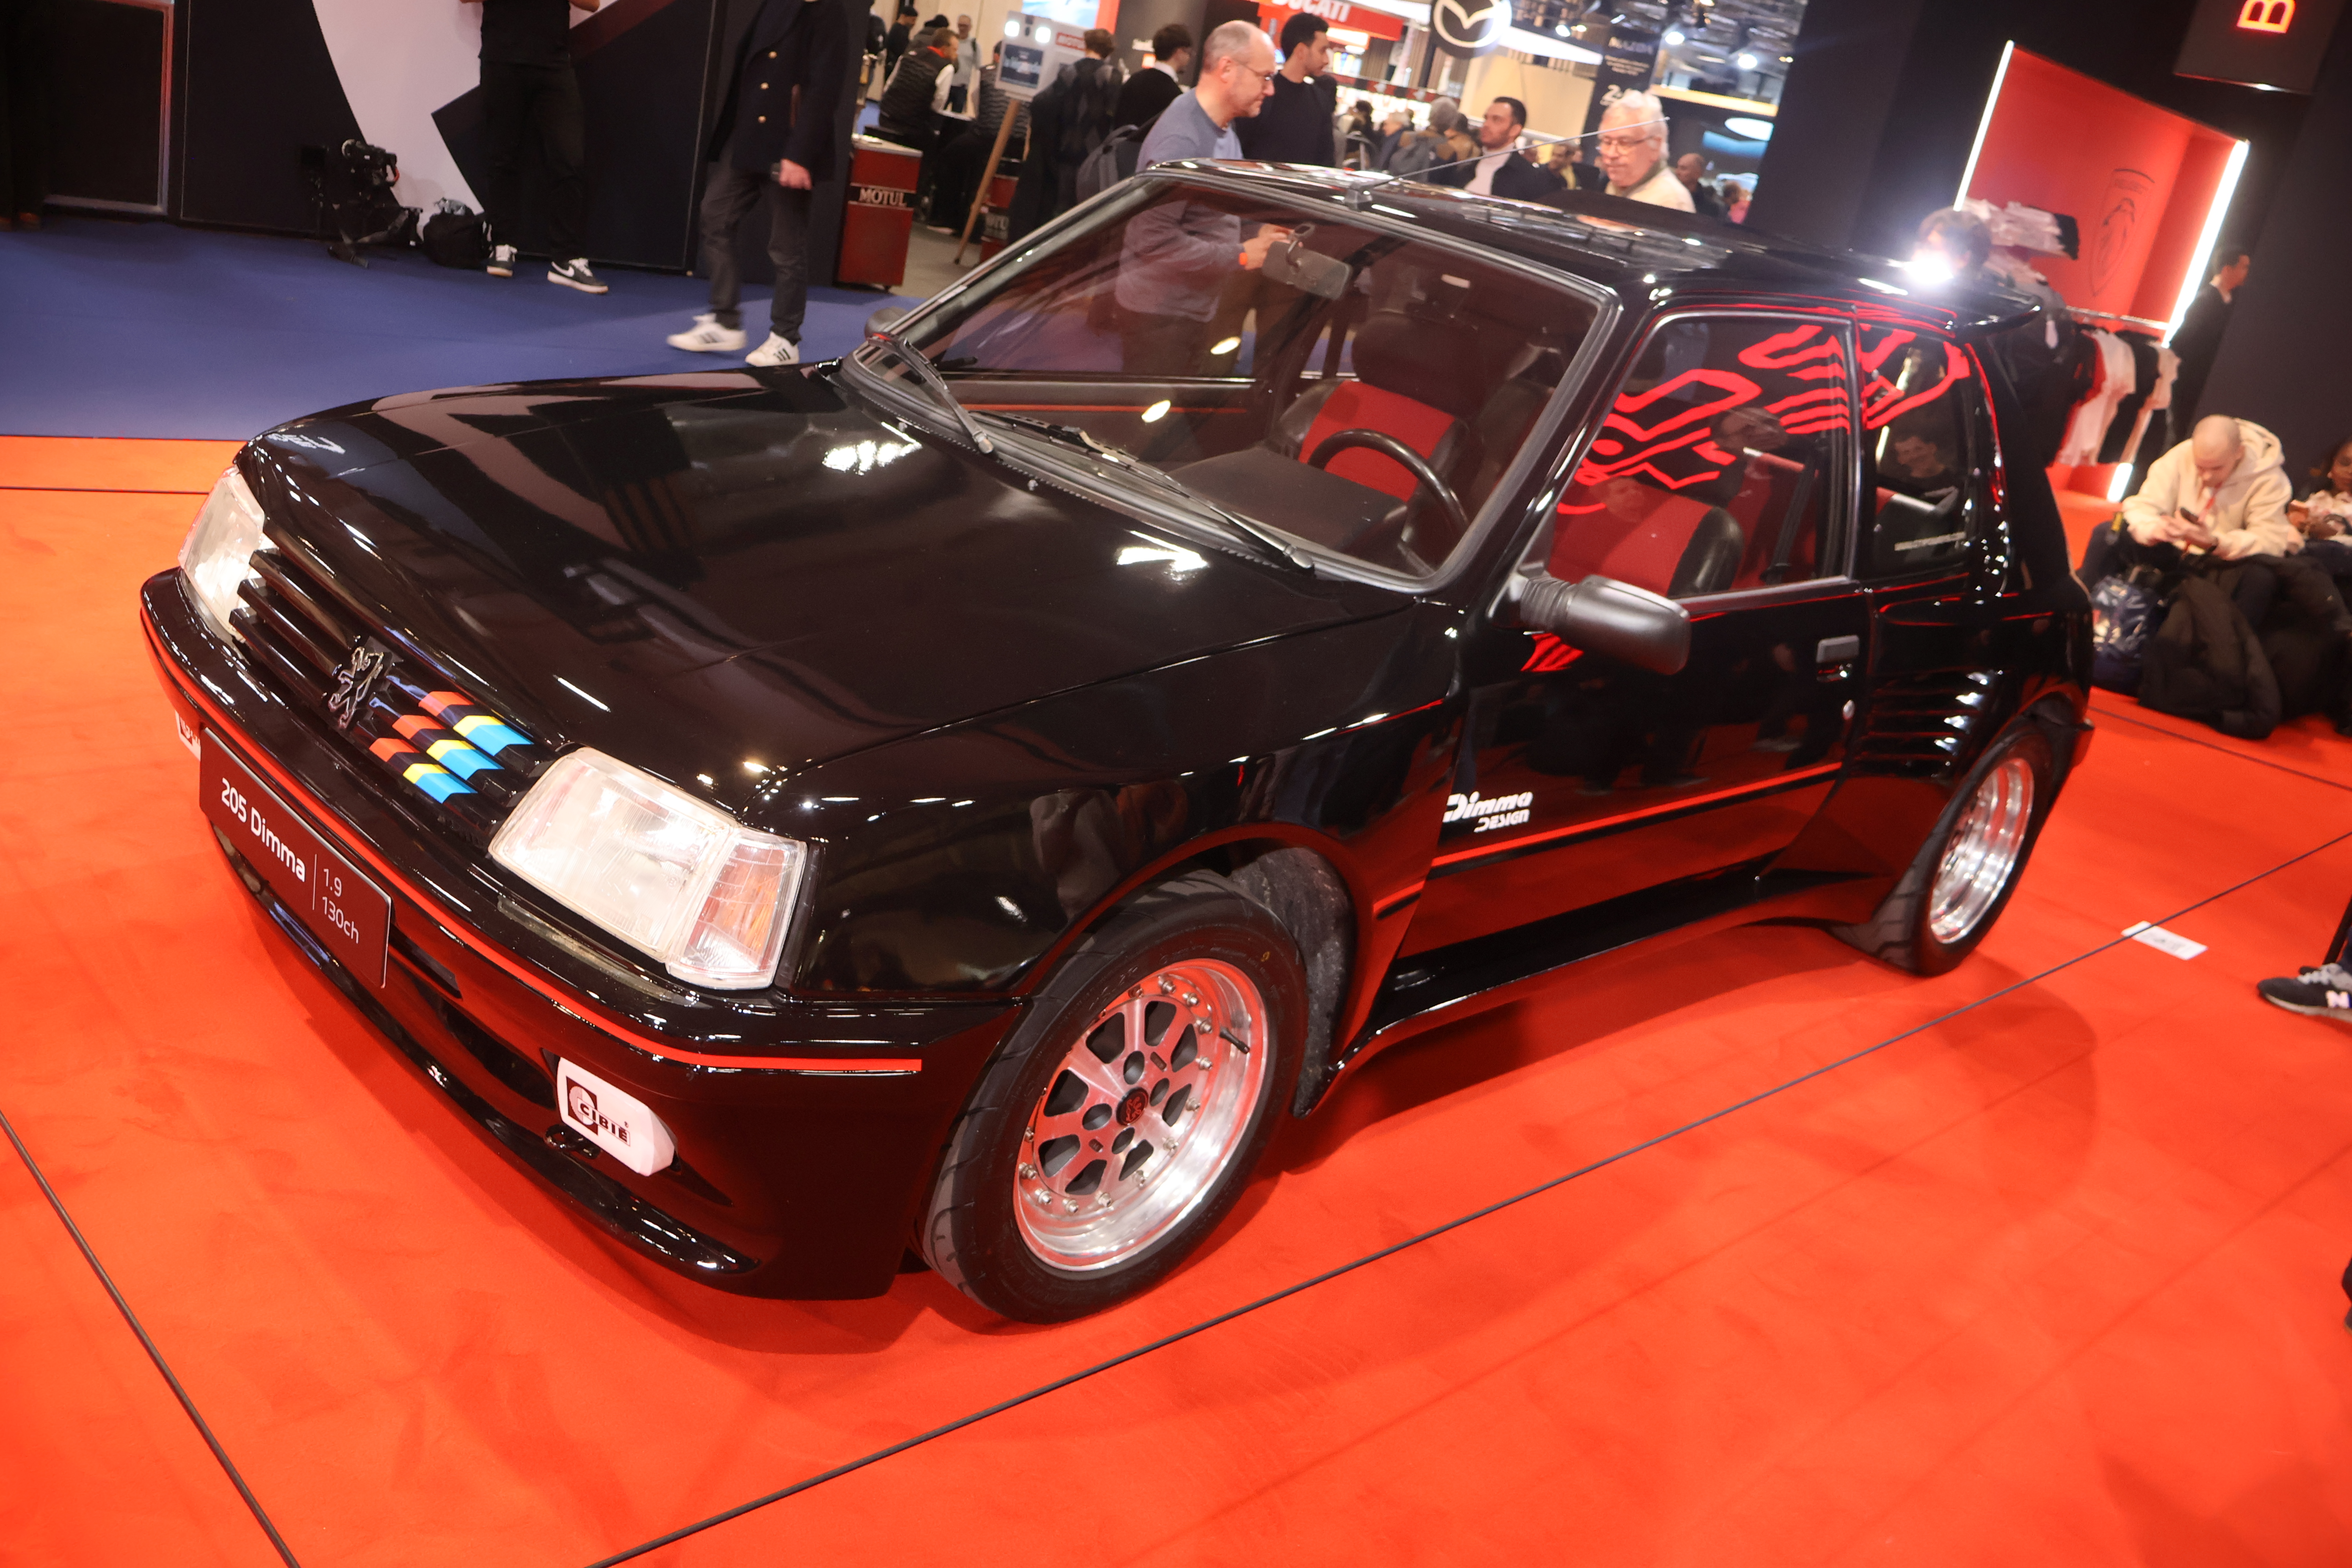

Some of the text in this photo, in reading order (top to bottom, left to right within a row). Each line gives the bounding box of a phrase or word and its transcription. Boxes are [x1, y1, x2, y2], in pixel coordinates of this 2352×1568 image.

[858, 187, 907, 207] MOTUL
[1442, 791, 1533, 822] Dimma
[221, 777, 305, 882] 205 Dimma
[323, 869, 342, 897] 1.9
[322, 897, 359, 944] 130ch
